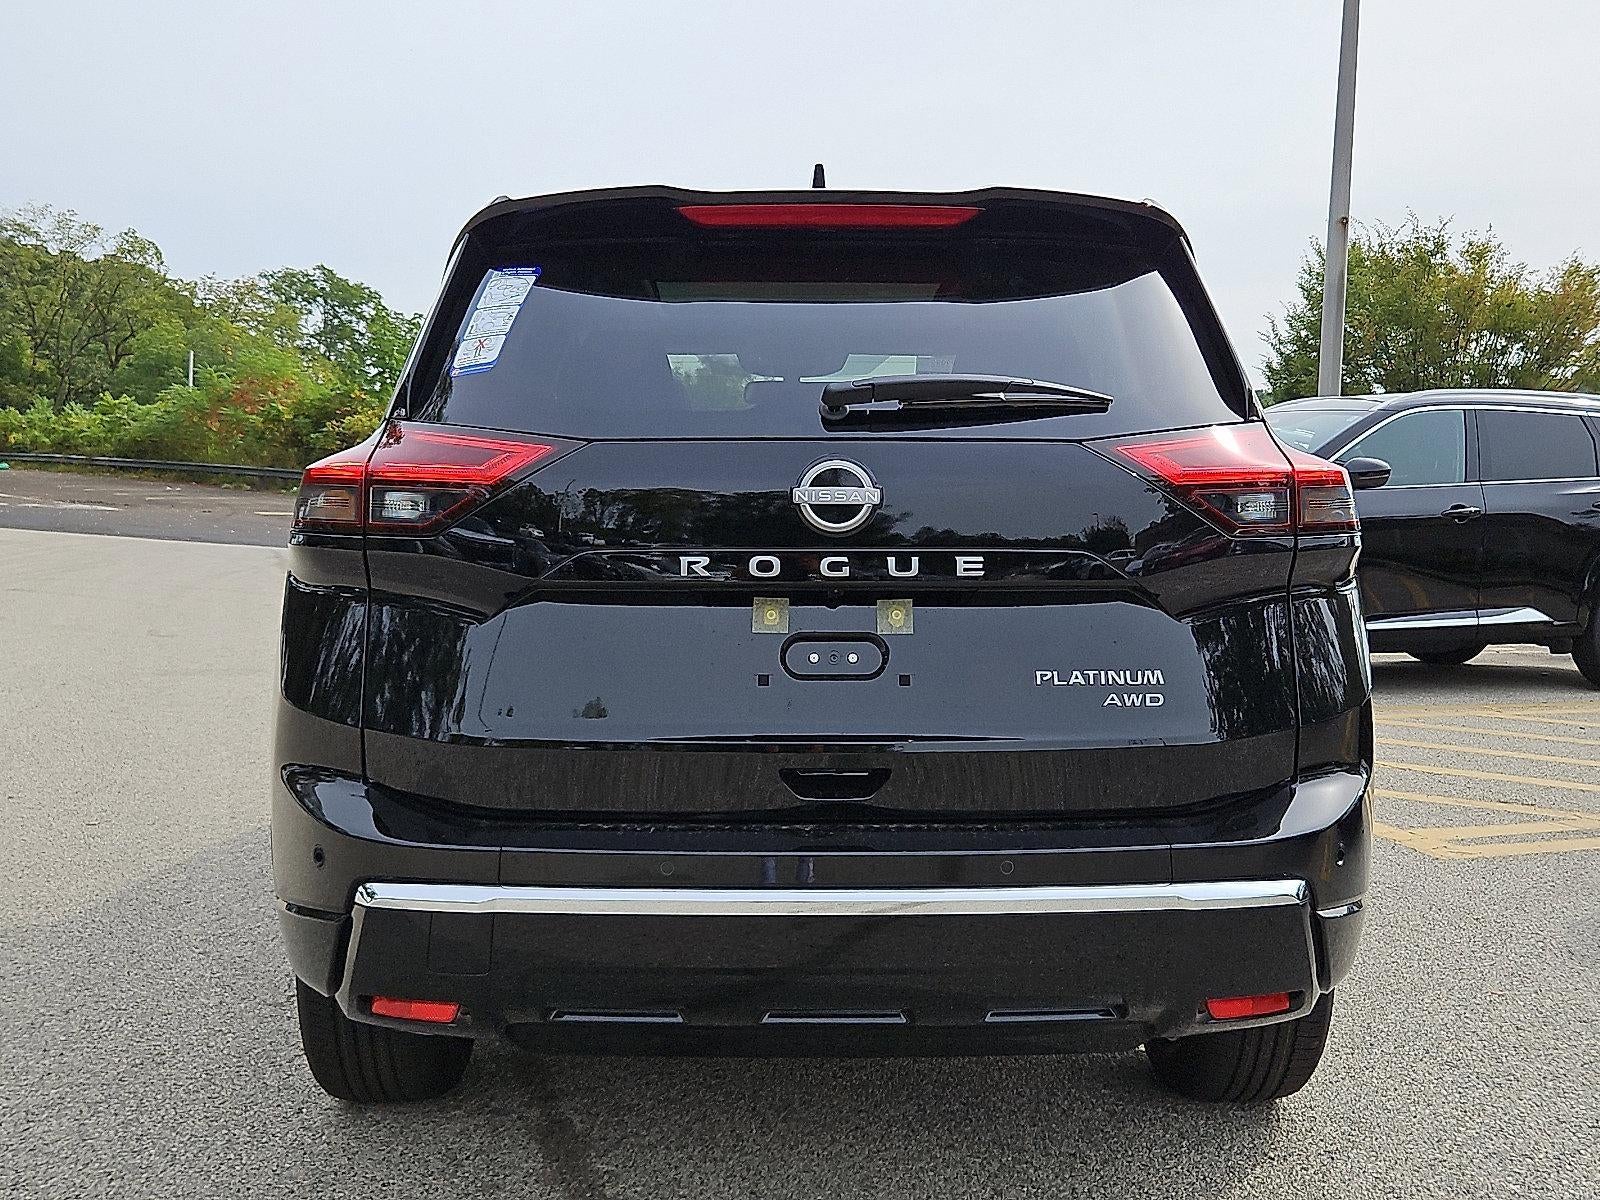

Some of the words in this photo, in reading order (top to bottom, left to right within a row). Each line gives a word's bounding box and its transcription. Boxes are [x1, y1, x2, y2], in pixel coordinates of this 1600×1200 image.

[795, 489, 878, 503] NISSAN
[679, 555, 986, 577] ROGUE
[1035, 669, 1165, 685] PLATINUM
[1103, 693, 1165, 707] AWD
